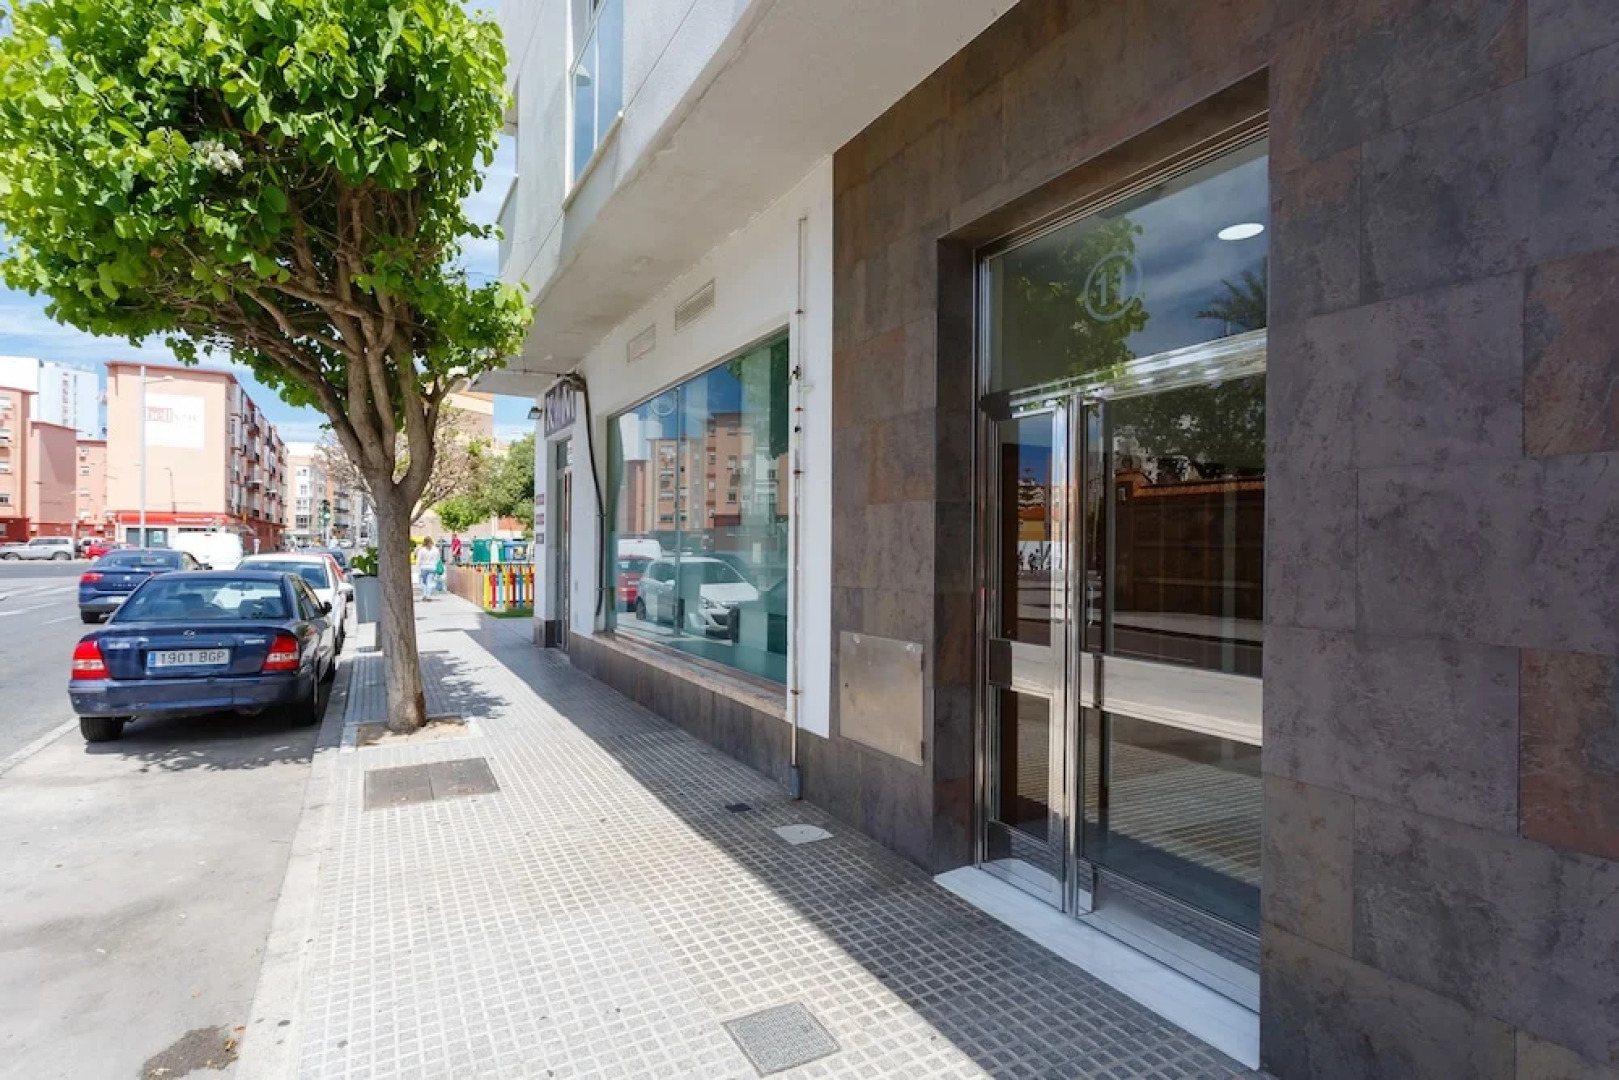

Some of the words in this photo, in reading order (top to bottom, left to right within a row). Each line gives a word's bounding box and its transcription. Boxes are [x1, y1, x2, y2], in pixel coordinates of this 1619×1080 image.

[1095, 265, 1126, 307] 11
[161, 652, 194, 664] 1901
[200, 650, 225, 663] BGP
